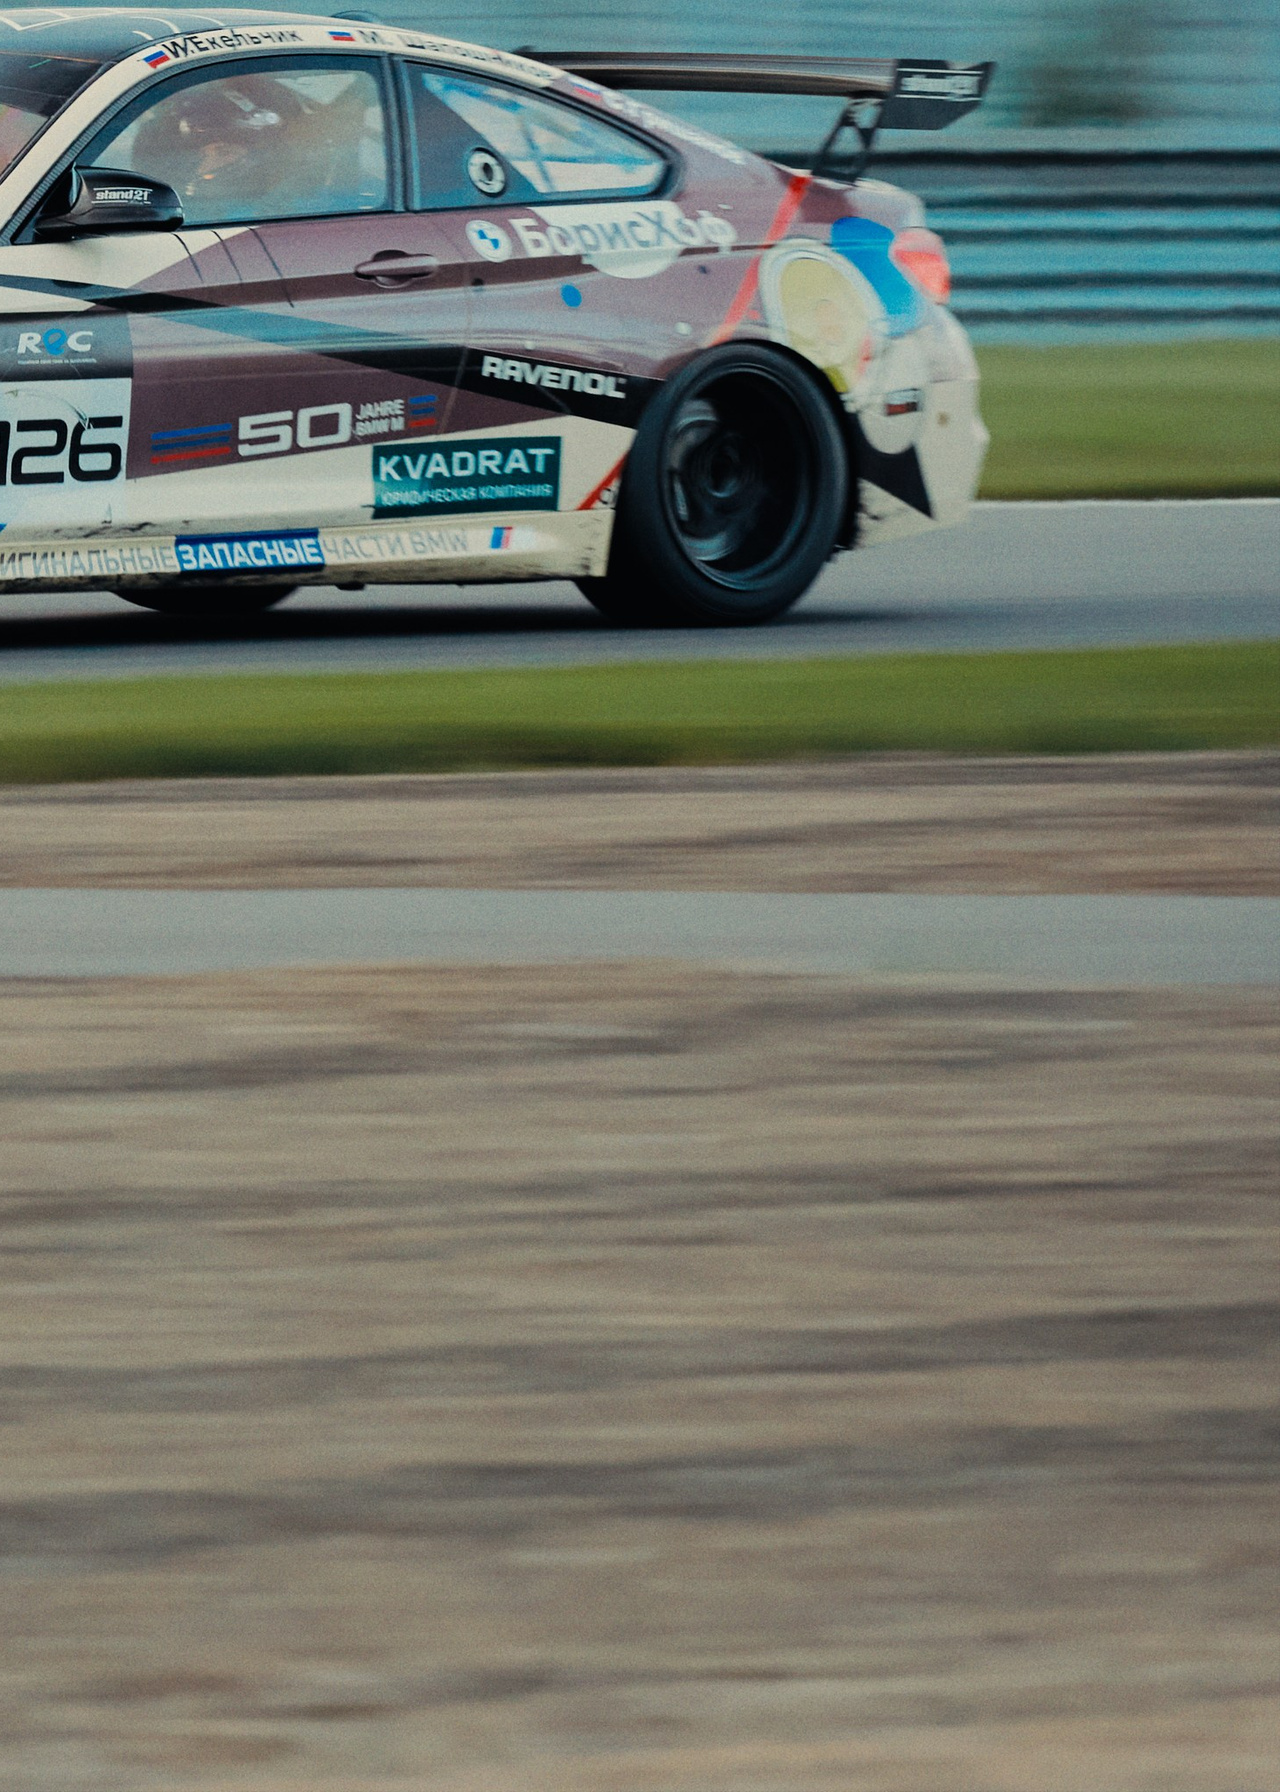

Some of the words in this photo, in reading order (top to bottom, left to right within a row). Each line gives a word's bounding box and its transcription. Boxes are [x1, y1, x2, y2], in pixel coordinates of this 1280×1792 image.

[96, 189, 149, 201] stand21
[508, 210, 738, 258] БорисХоф
[481, 355, 627, 399] RAVENOL
[237, 402, 352, 457] 50
[379, 448, 556, 481] KVADRAT
[178, 538, 324, 570] ЗАПАСНЫЕ
[322, 533, 402, 560] ЧАСТИ
[410, 528, 469, 555] BMW
